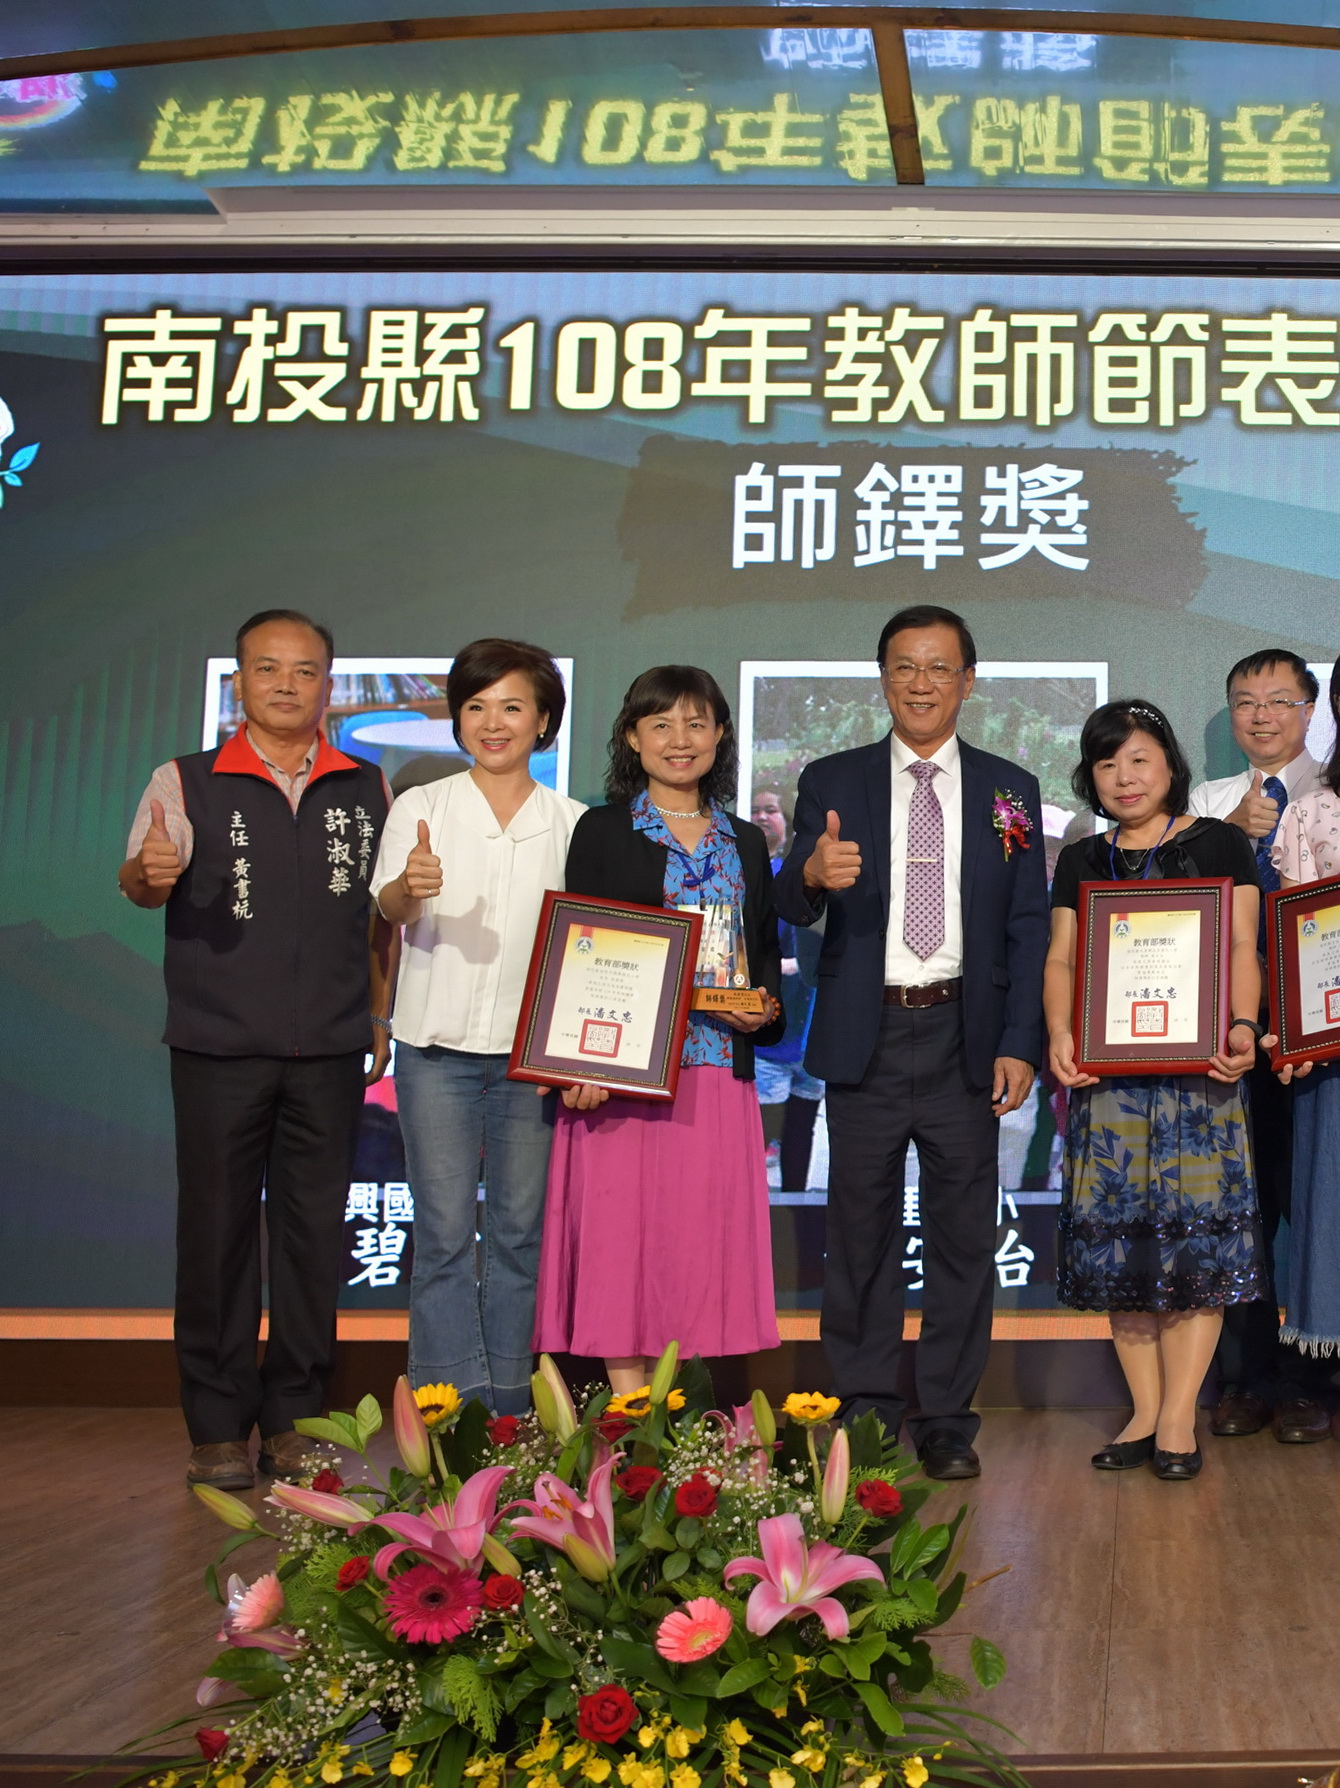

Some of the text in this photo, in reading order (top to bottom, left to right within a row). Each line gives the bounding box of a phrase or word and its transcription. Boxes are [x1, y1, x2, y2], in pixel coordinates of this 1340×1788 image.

[732, 461, 1090, 571] 師鐸獎
[230, 810, 249, 847] 主任
[323, 808, 355, 897] 許淑華
[354, 805, 375, 881] 立法委員
[347, 1222, 408, 1288] 碧
